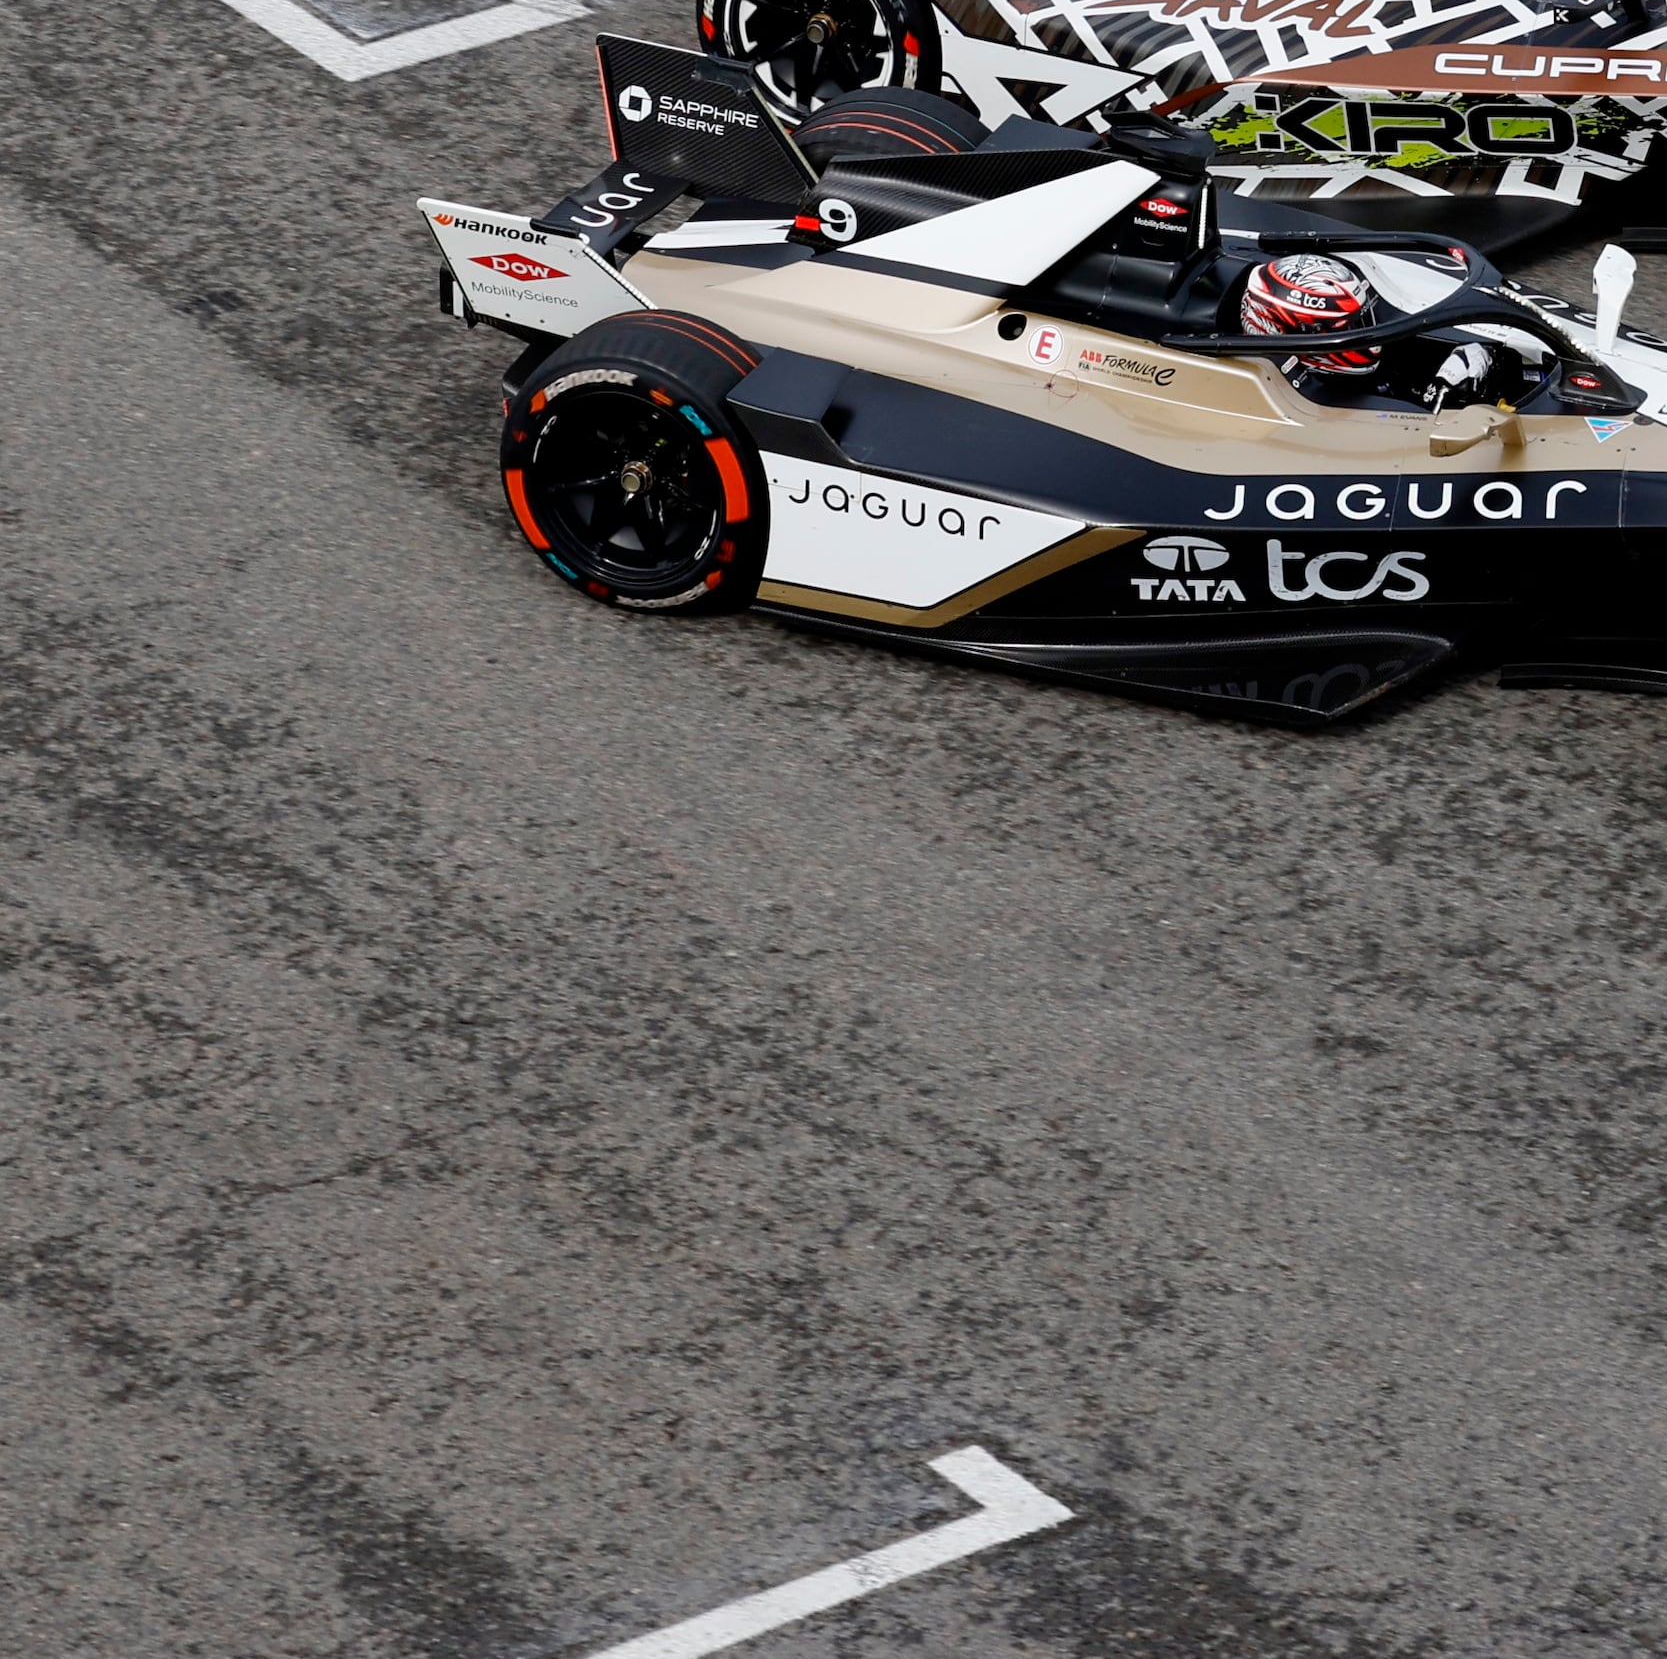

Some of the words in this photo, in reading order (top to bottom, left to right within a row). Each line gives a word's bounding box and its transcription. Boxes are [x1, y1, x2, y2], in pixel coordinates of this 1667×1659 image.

[656, 111, 726, 137] RESERVE
[658, 93, 760, 130] SAPPHIRE
[819, 198, 858, 242] 9
[471, 280, 580, 309] MobilityScience
[1303, 293, 1326, 309] tcs
[1036, 330, 1056, 360] E
[1079, 348, 1102, 364] ABB
[1102, 354, 1156, 378] FORMULA
[1130, 577, 1247, 603] TATA
[1267, 538, 1431, 602] tcs
